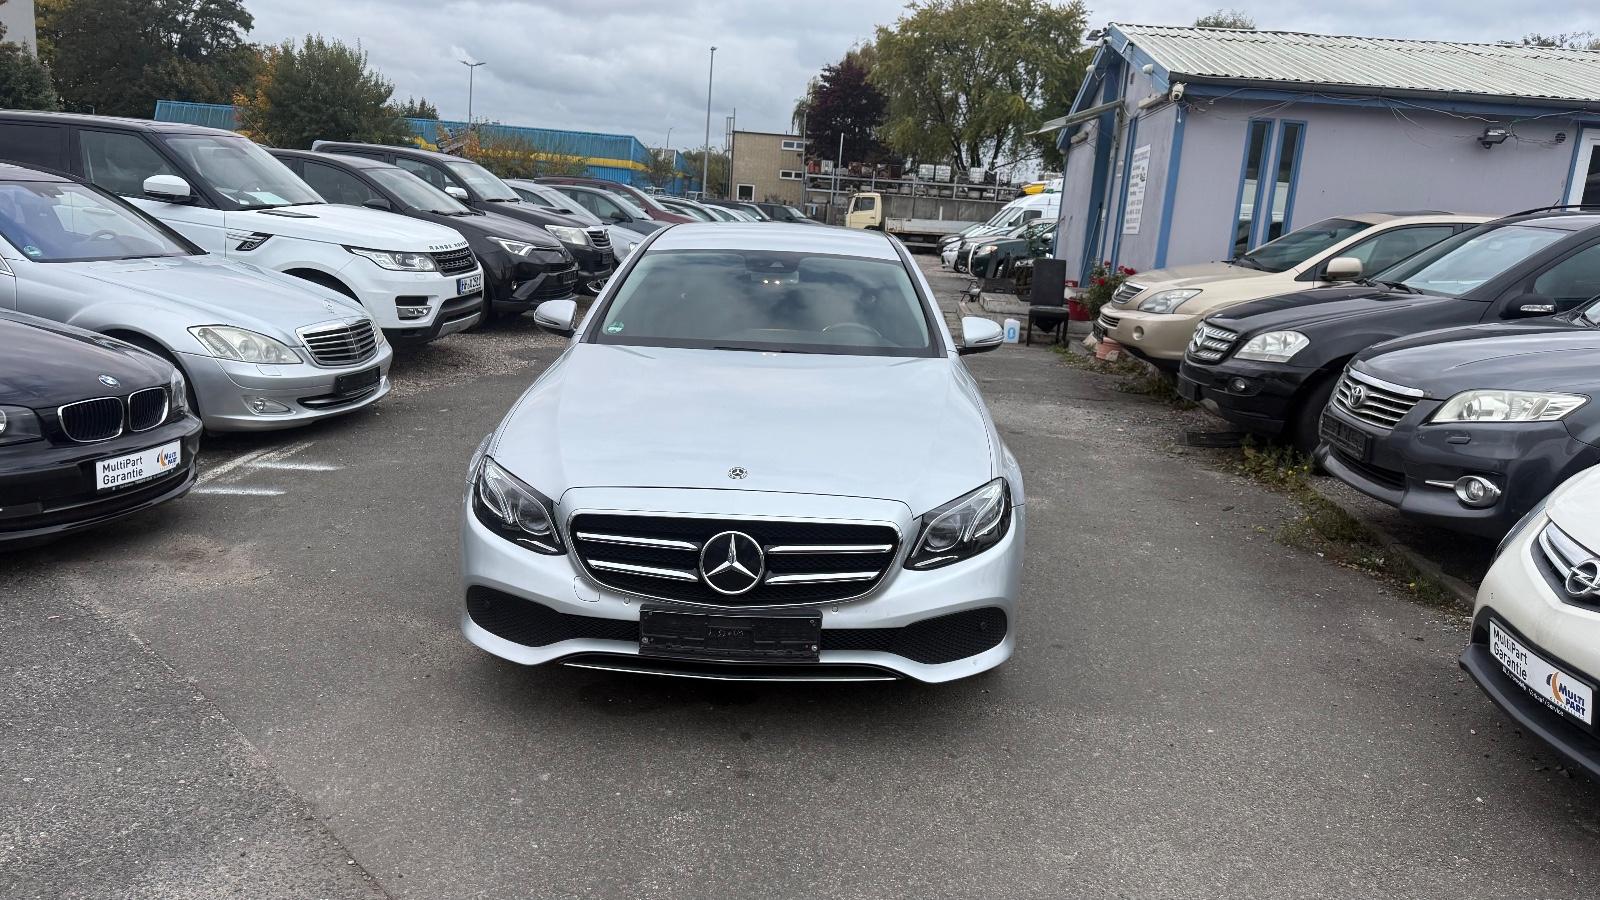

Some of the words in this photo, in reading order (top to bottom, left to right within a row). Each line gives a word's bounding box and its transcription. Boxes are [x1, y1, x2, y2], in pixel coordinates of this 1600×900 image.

[103, 455, 143, 474] MultiPart
[103, 468, 143, 485] Garantie
[1493, 626, 1528, 665] MultiPart
[1493, 641, 1527, 681] Garantie
[1558, 682, 1585, 706] MULTI
[1565, 698, 1586, 716] PART
